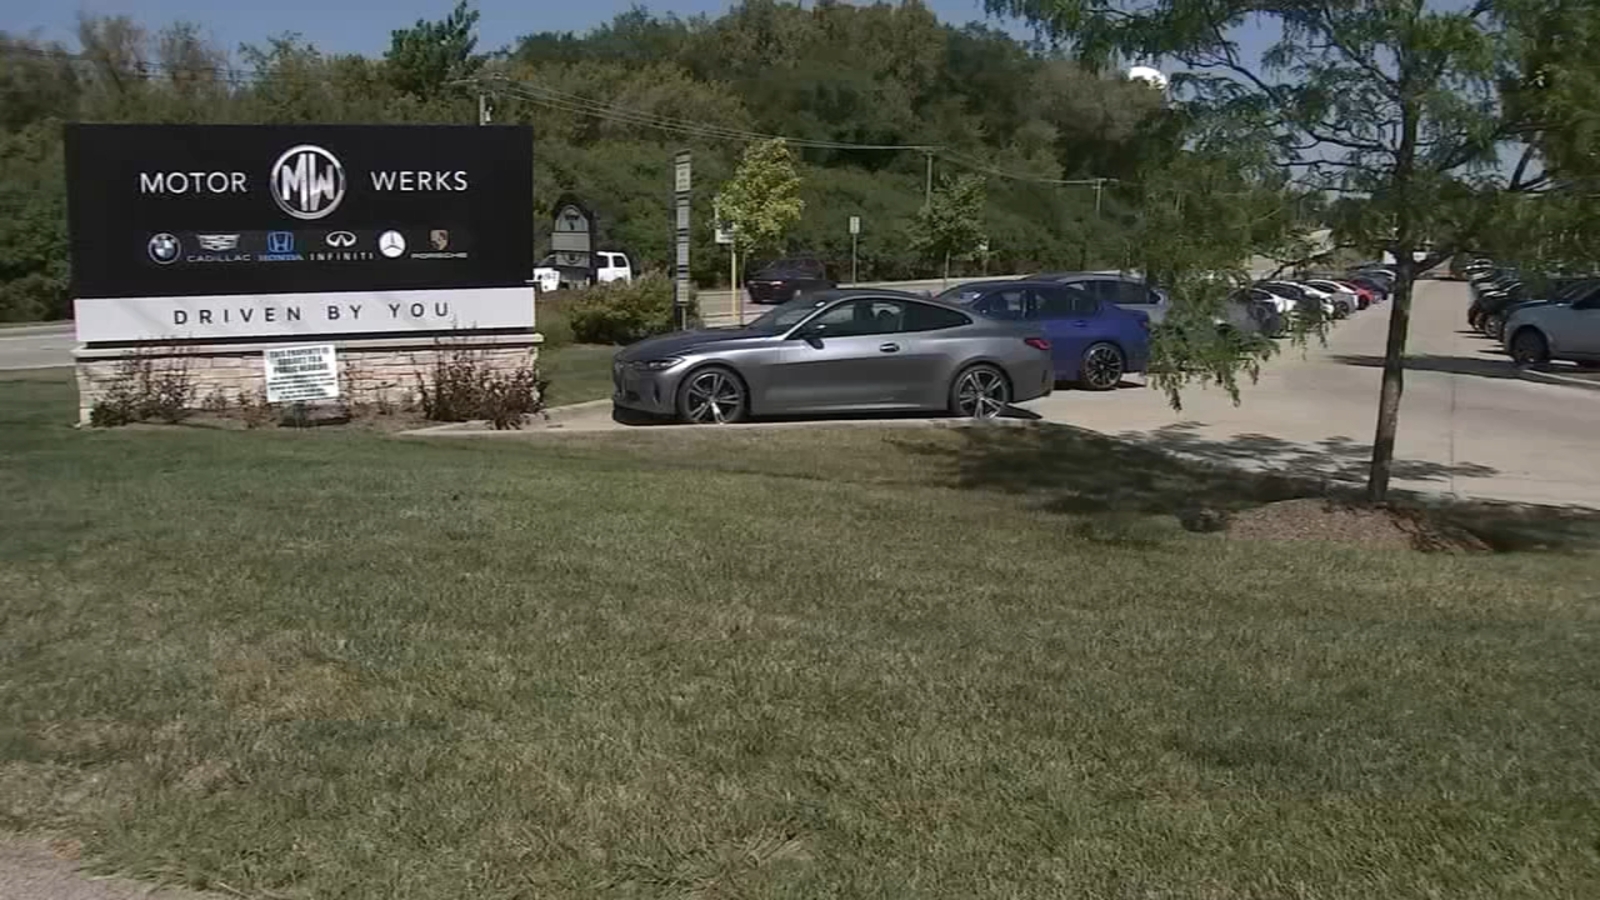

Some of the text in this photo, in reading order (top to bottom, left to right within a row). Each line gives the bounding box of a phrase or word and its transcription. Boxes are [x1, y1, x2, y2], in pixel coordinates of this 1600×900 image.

[140, 172, 248, 194] MOTOR
[370, 170, 468, 191] WERKS
[187, 254, 251, 262] CADILLAC
[309, 252, 374, 261] INFINITI
[173, 302, 449, 325] DRIVEN BY YOU
